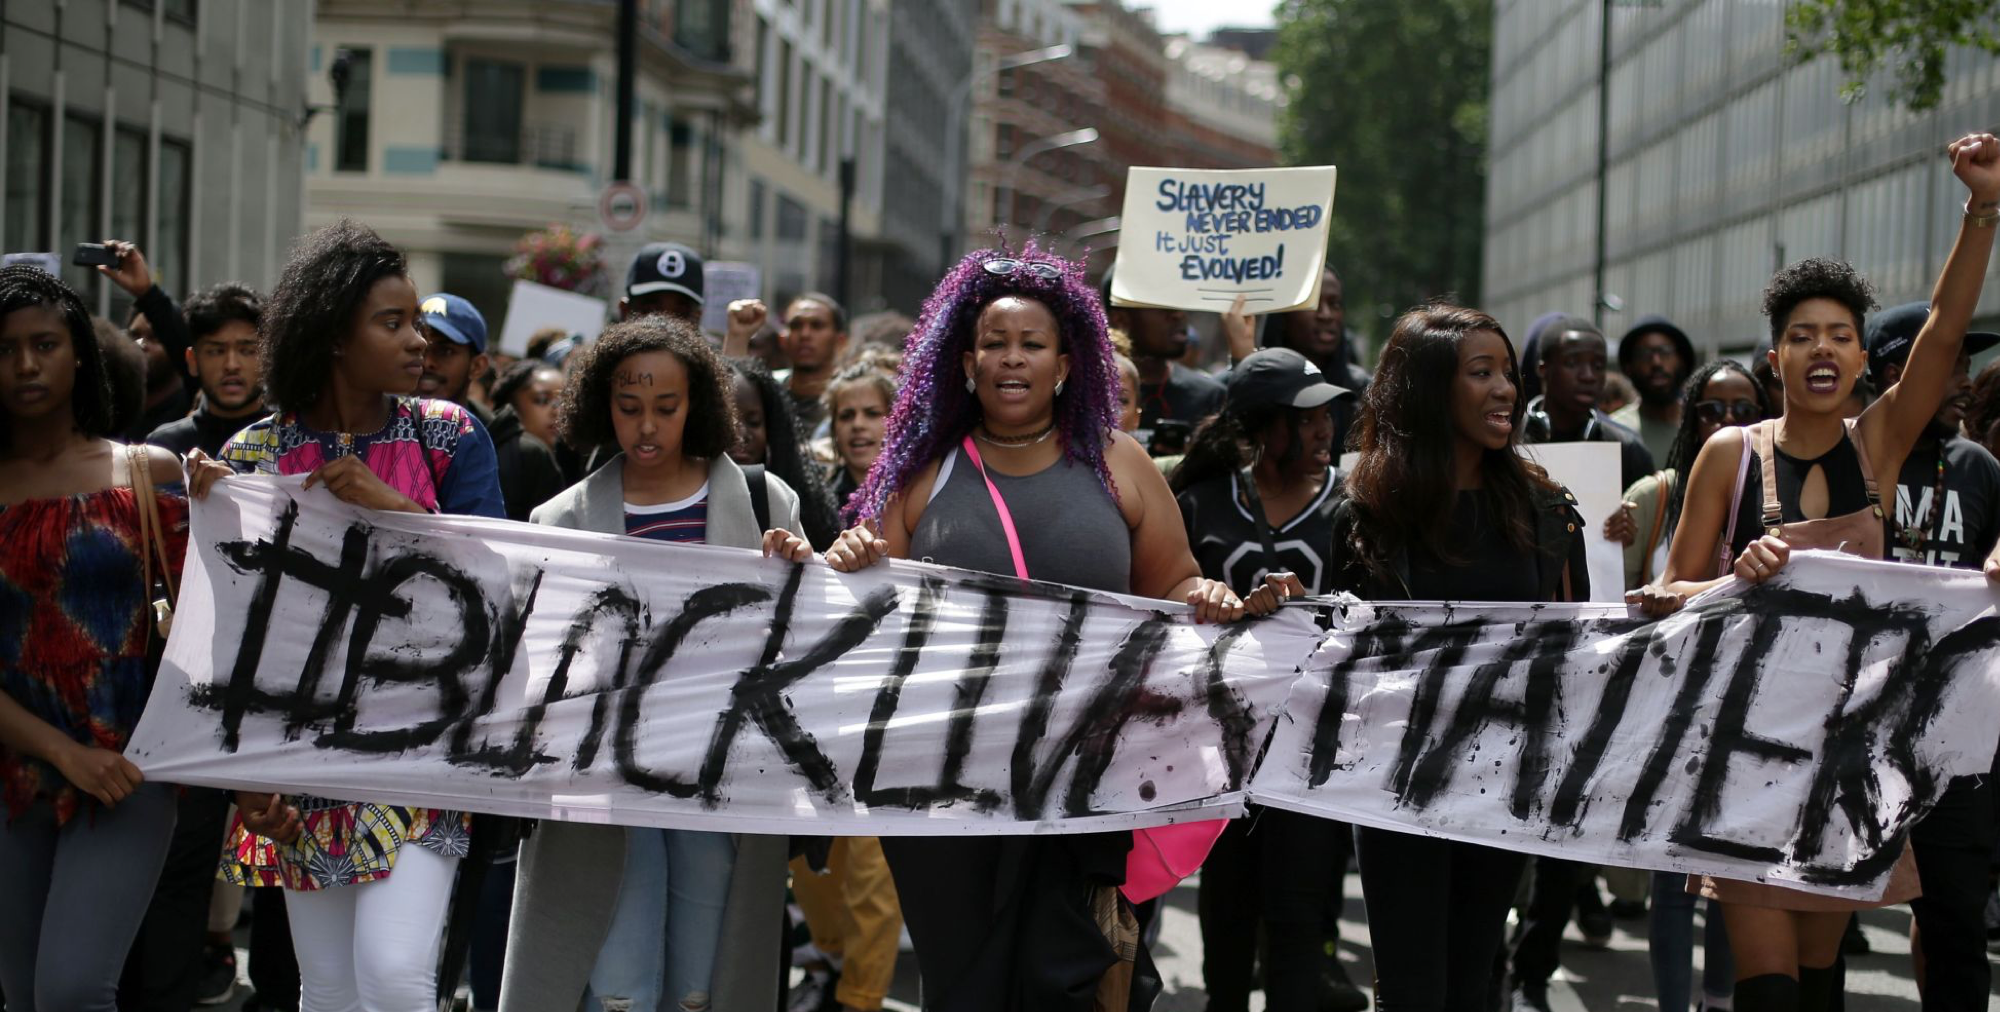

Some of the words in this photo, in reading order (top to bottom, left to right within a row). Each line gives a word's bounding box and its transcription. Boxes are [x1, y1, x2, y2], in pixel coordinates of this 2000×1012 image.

[1156, 179, 1265, 212] SLAVERY
[1186, 211, 1252, 234] NEVER
[1255, 205, 1323, 232] ENDED
[1178, 234, 1232, 255] JUST
[1179, 243, 1284, 285] EVOLVED!
[619, 370, 653, 387] BLM
